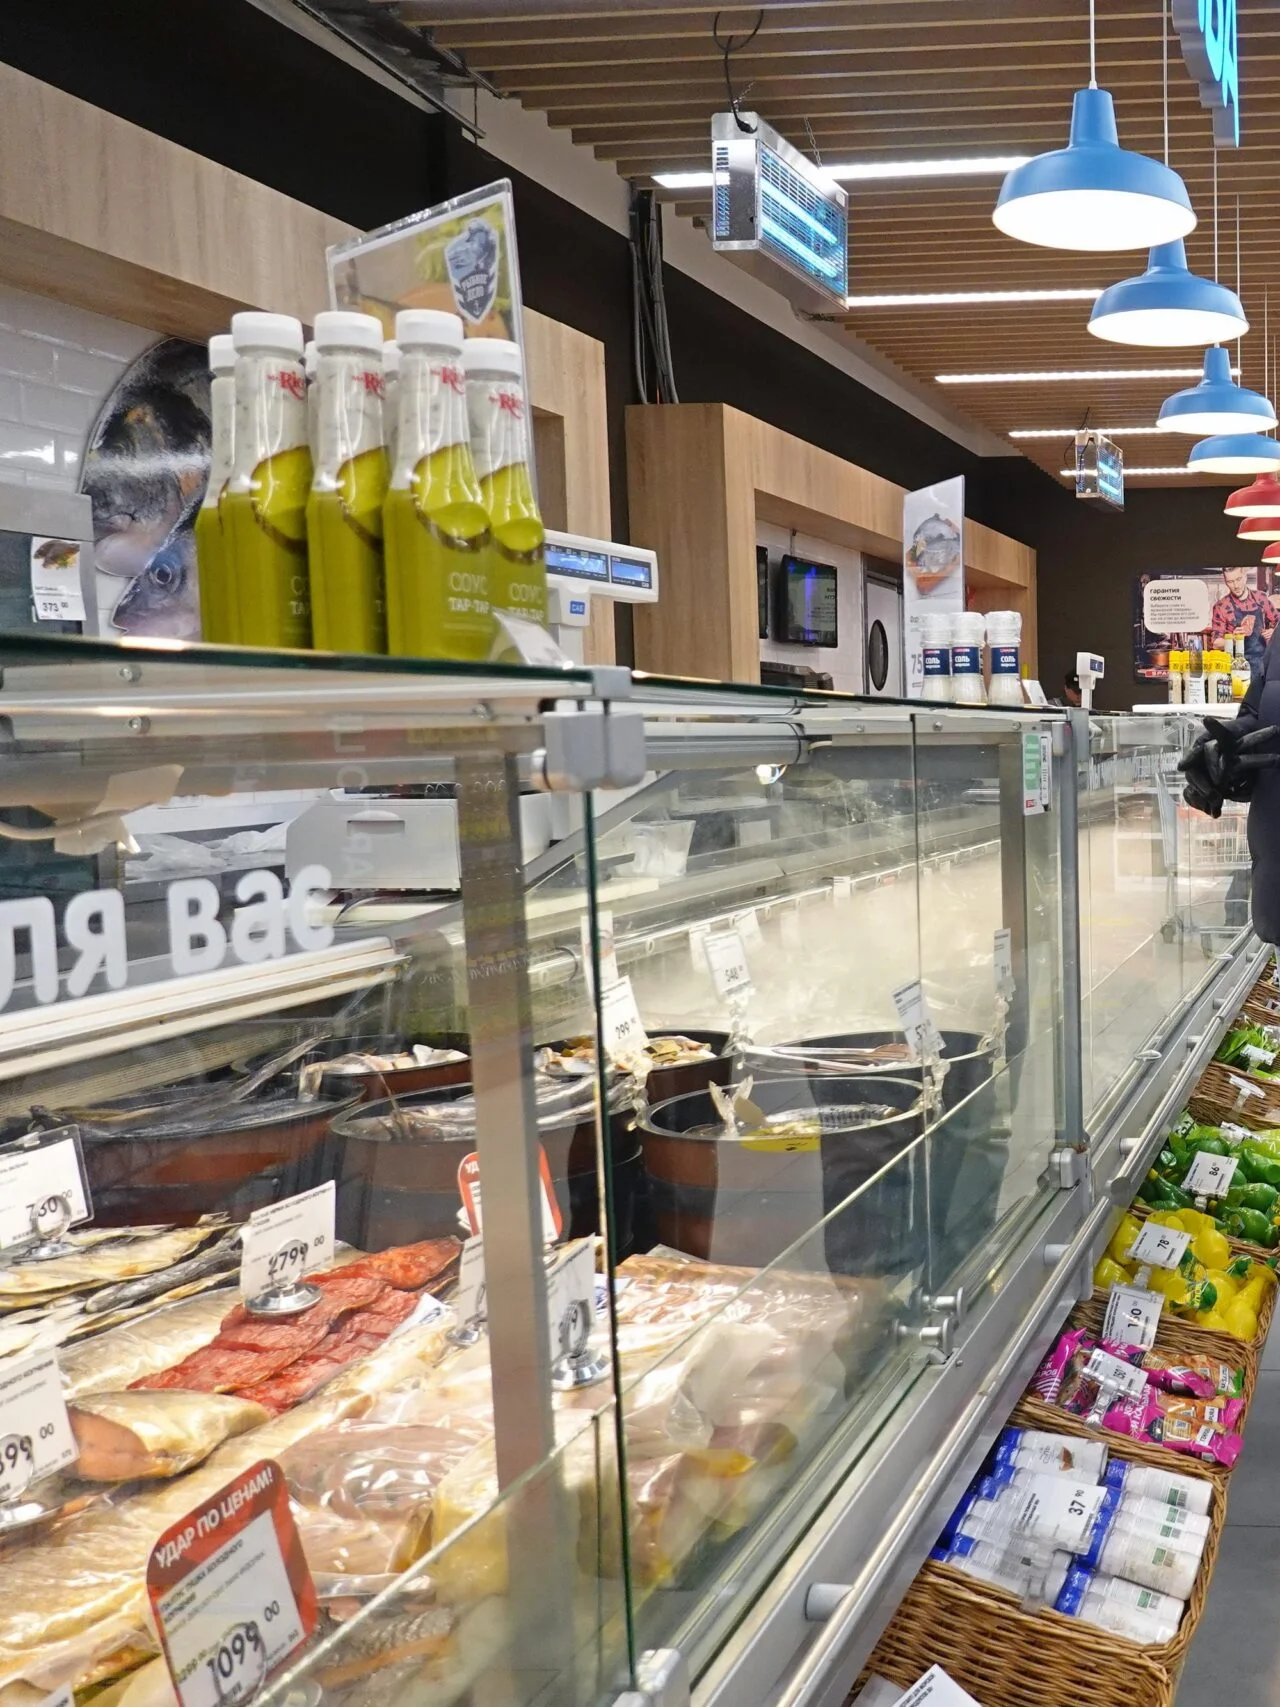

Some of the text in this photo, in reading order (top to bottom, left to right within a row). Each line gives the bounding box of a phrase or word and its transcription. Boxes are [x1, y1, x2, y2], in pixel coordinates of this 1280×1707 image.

[571, 603, 584, 614] CAS
[168, 865, 335, 976] вас
[1209, 1166, 1220, 1177] 86
[1156, 1238, 1170, 1250] 78
[40, 1422, 54, 1439] 00
[1068, 1500, 1087, 1516] 37
[155, 1466, 273, 1569] УДАР ПО ЦЕНАМ!
[206, 1619, 259, 1679] 1099
[263, 1599, 281, 1622] 00
